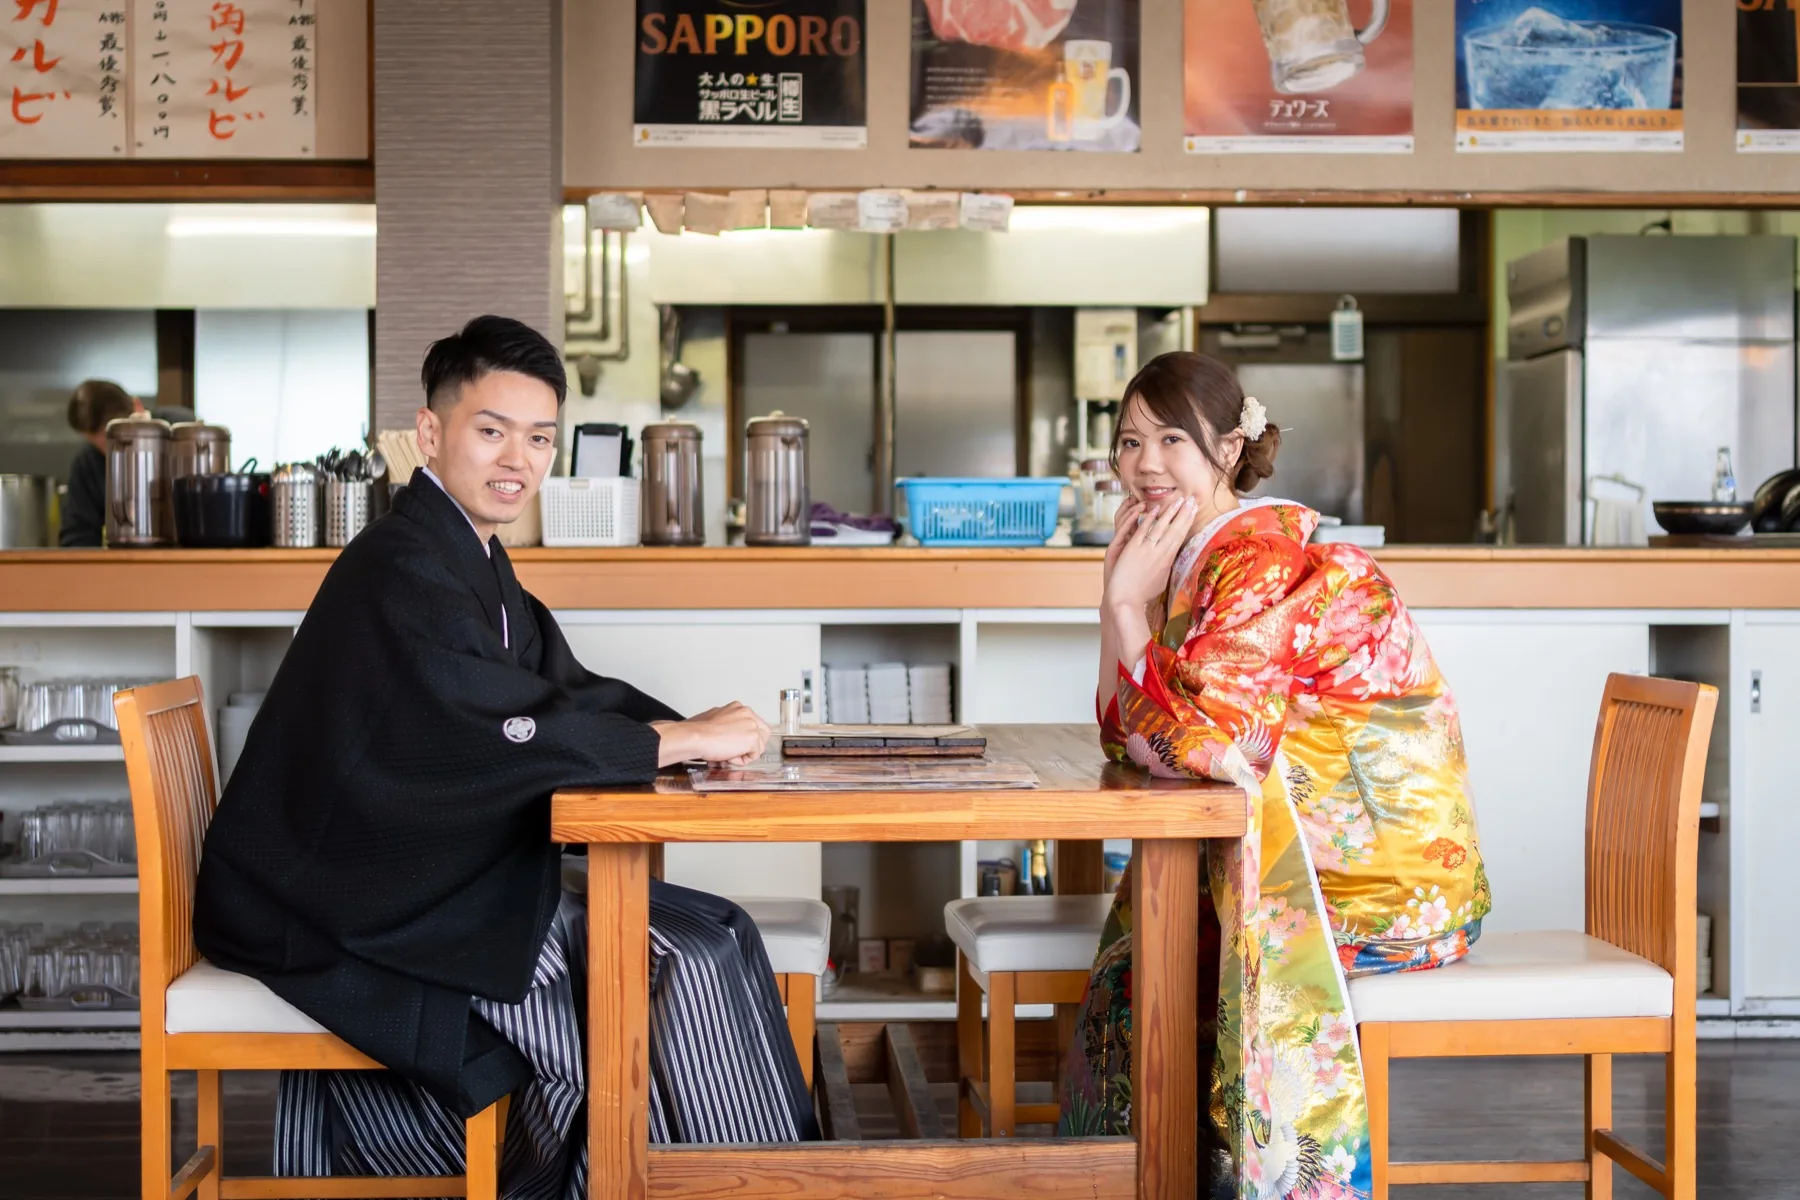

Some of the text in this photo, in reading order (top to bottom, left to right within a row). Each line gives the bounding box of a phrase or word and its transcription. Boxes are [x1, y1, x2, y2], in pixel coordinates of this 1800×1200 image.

[641, 13, 861, 56] SAPPORO
[205, 2, 265, 140] 角カルビ
[698, 89, 778, 101] サッポロ生ビール
[698, 100, 778, 121] 黒ラベル
